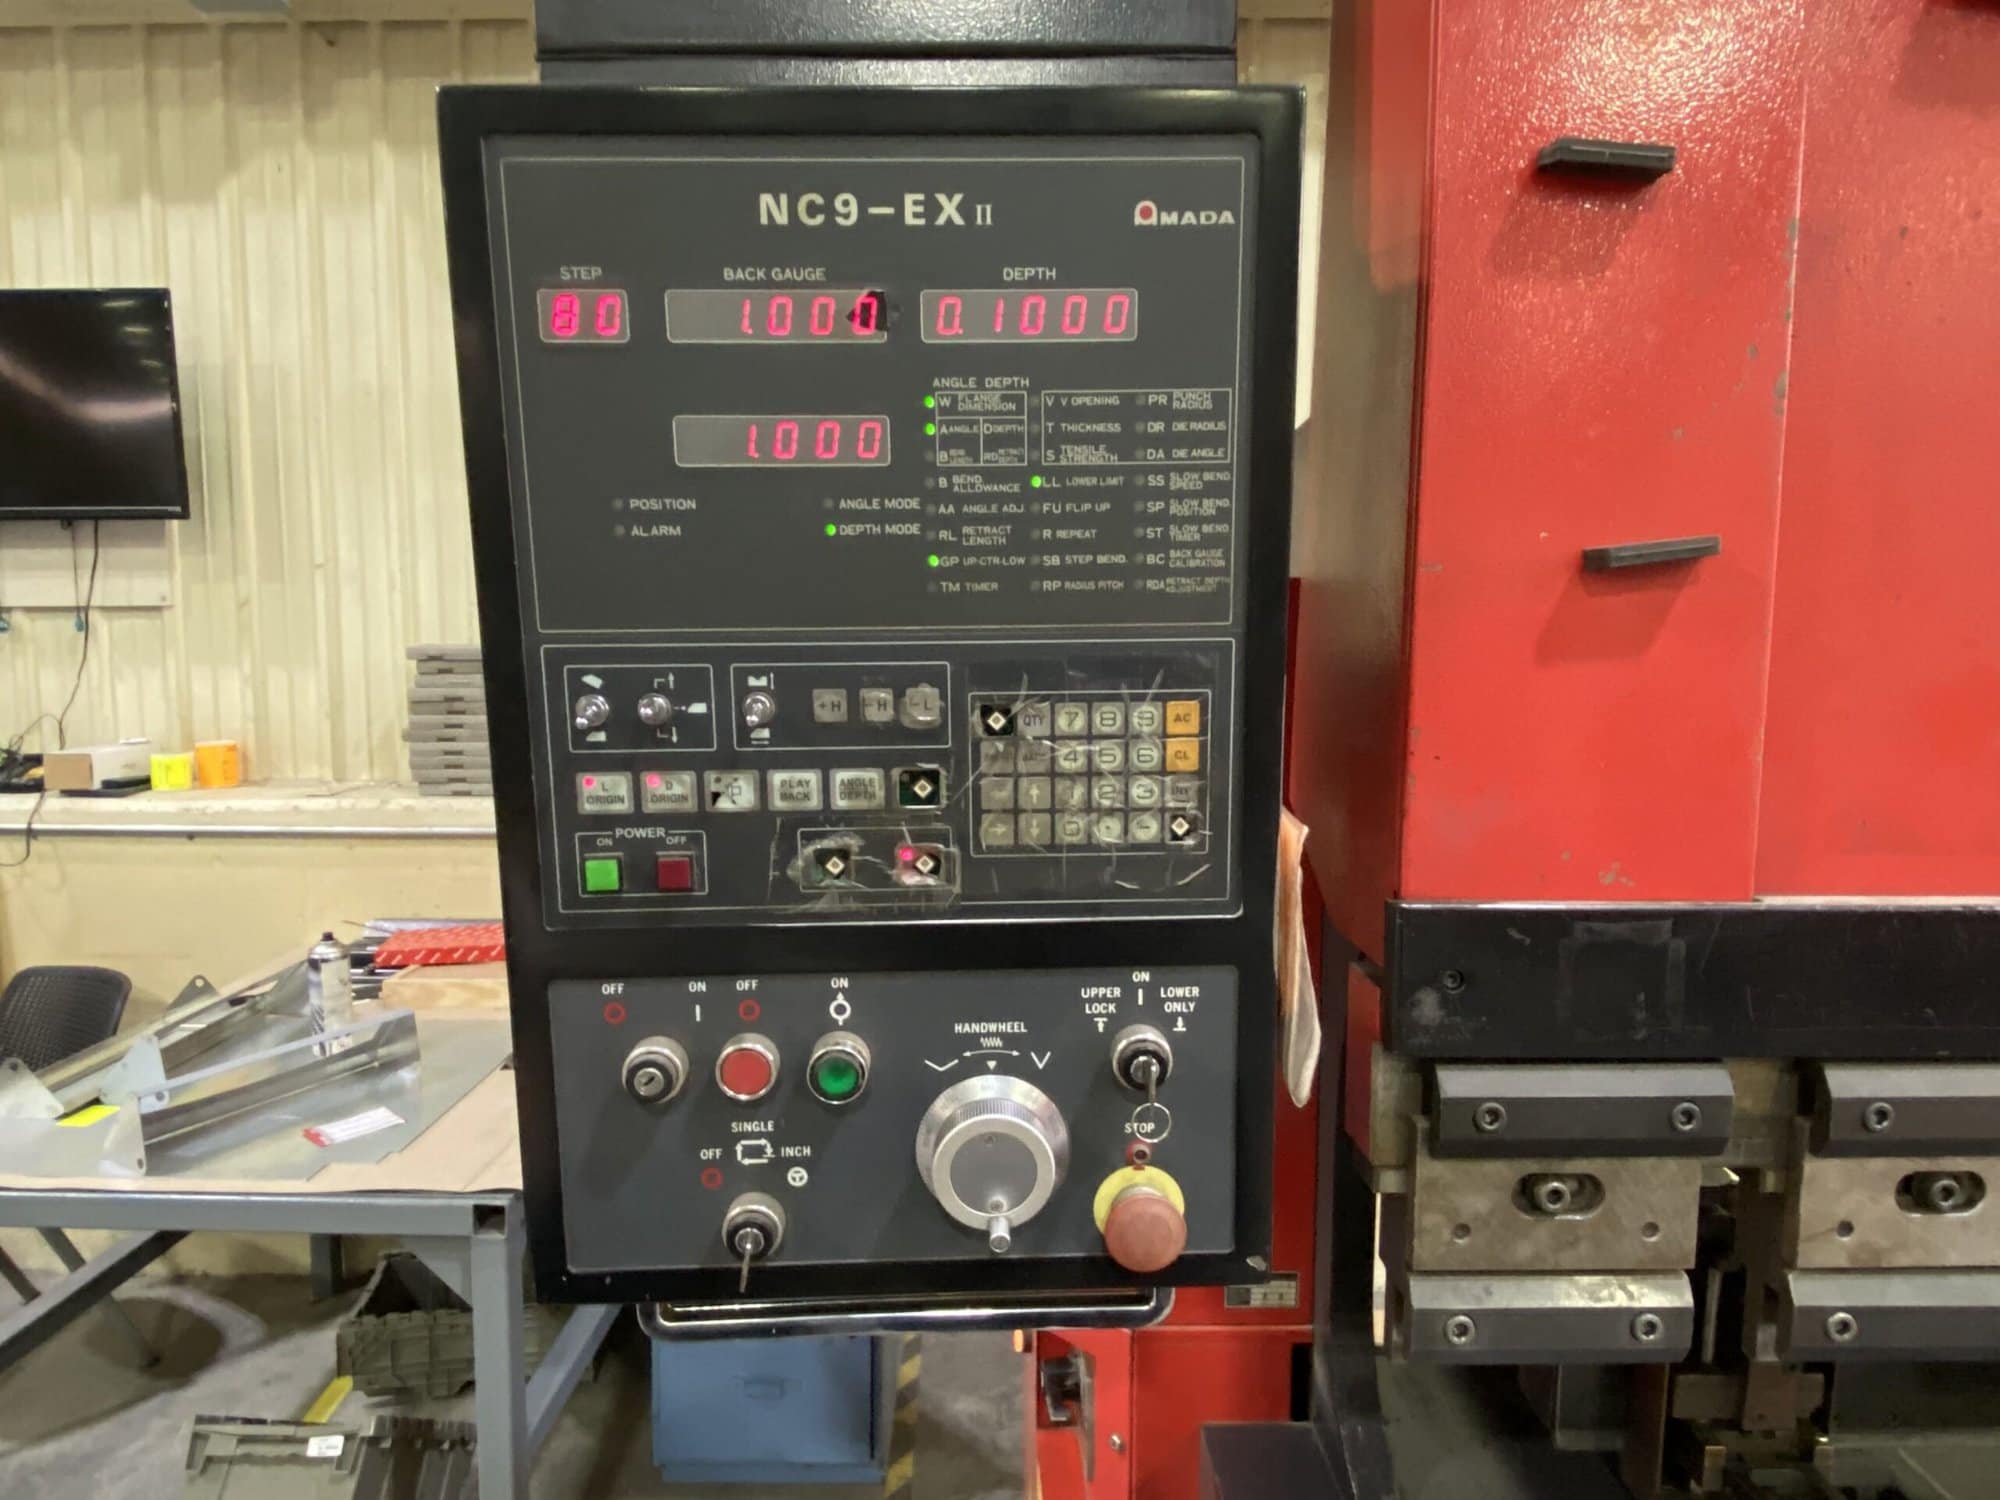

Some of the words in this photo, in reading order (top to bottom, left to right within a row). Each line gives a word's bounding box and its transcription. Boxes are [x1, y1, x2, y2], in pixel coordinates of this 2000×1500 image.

[1134, 200, 1236, 226] AMADA
[559, 265, 603, 281] STEP
[723, 267, 767, 282] BACK
[771, 267, 827, 282] GAUGE
[1002, 267, 1058, 282] DEPTH
[551, 294, 622, 337] 80
[935, 294, 1130, 336] 0.1000
[932, 377, 977, 389] ANGLE
[985, 377, 1030, 389] DEPTH
[1045, 395, 1055, 407] V
[1071, 395, 1120, 406] OPENING
[1148, 394, 1168, 406] PR
[1172, 391, 1212, 401] PUNCH
[940, 396, 952, 409] W
[958, 401, 1016, 412] DIMENSION
[1172, 400, 1213, 410] RADIUS
[940, 424, 949, 435] A
[949, 425, 979, 433] ANGLE
[983, 423, 993, 435] D
[993, 425, 1025, 433] DEPTH
[1046, 422, 1055, 434] T
[1060, 422, 1122, 433] THICKNESS
[1147, 422, 1165, 433] DR
[1190, 421, 1227, 432] RADIUS
[747, 419, 882, 460] 1.000
[1046, 449, 1056, 461] S
[1146, 448, 1166, 460] DA
[1190, 447, 1226, 458] ANGLE
[952, 474, 983, 485] BEND
[1043, 476, 1061, 488] LL
[1066, 476, 1098, 487] LOWER
[1147, 474, 1166, 487] SS
[1202, 471, 1232, 481] BEND
[938, 477, 948, 488] B
[953, 483, 1021, 493] ALLOWANCE
[629, 498, 697, 510] POSITION
[838, 498, 881, 510] ANGLE
[884, 498, 921, 510] MODE
[938, 503, 956, 515] AA
[962, 503, 998, 514] ANGLE
[1042, 502, 1062, 514] FU
[1065, 502, 1092, 513] FLIP
[1095, 502, 1111, 513] UP
[1146, 500, 1166, 513] SP
[630, 524, 682, 537] ALARM
[838, 524, 881, 536] DEPTH
[884, 523, 921, 535] MODE
[938, 529, 958, 542] RL
[961, 525, 1013, 536] RETRACT
[1042, 528, 1053, 541] R
[1056, 529, 1098, 539] REPEAT
[1146, 526, 1165, 539] ST
[961, 535, 1008, 546] LENGTH
[1146, 553, 1166, 565] BC
[1169, 549, 1194, 559] BACK
[940, 555, 960, 568] GP
[1042, 554, 1061, 567] SB
[1064, 554, 1095, 566] STEP
[1169, 558, 1227, 568] CALIBRATION
[940, 581, 961, 593] TM
[964, 581, 999, 592] TIMER
[1042, 580, 1062, 592] RP
[1146, 579, 1165, 591] RDA
[1064, 711, 1080, 729] 7
[1099, 711, 1117, 727] 8
[1173, 713, 1192, 723] AC
[1063, 749, 1079, 763] 4
[1100, 749, 1116, 763] 5
[1137, 748, 1155, 764] 6
[1174, 751, 1190, 761] CL
[665, 780, 674, 791] D
[780, 779, 811, 790] PLAY
[780, 791, 810, 802] BACK
[1100, 784, 1115, 799] 2
[1136, 783, 1155, 799] 3
[586, 795, 625, 805] ORIGIN
[650, 793, 689, 804] ORIGIN
[615, 827, 666, 839] POWER
[596, 837, 613, 847] ON
[665, 836, 687, 846] OFF
[831, 977, 849, 989] ON
[1132, 971, 1150, 984] ON
[602, 983, 624, 995] OFF
[688, 981, 706, 993] ON
[736, 979, 758, 992] OFF
[1081, 986, 1121, 999] UPPER
[1160, 986, 1200, 998] LOWER
[1085, 1001, 1116, 1014] LOCK
[1164, 1000, 1196, 1014] ONLY
[954, 1021, 1028, 1034] HANDWHEEL
[731, 1120, 774, 1133] SINGLE
[1124, 1122, 1155, 1134] STOP
[700, 1148, 723, 1161] OFF
[781, 1146, 811, 1158] INCH
